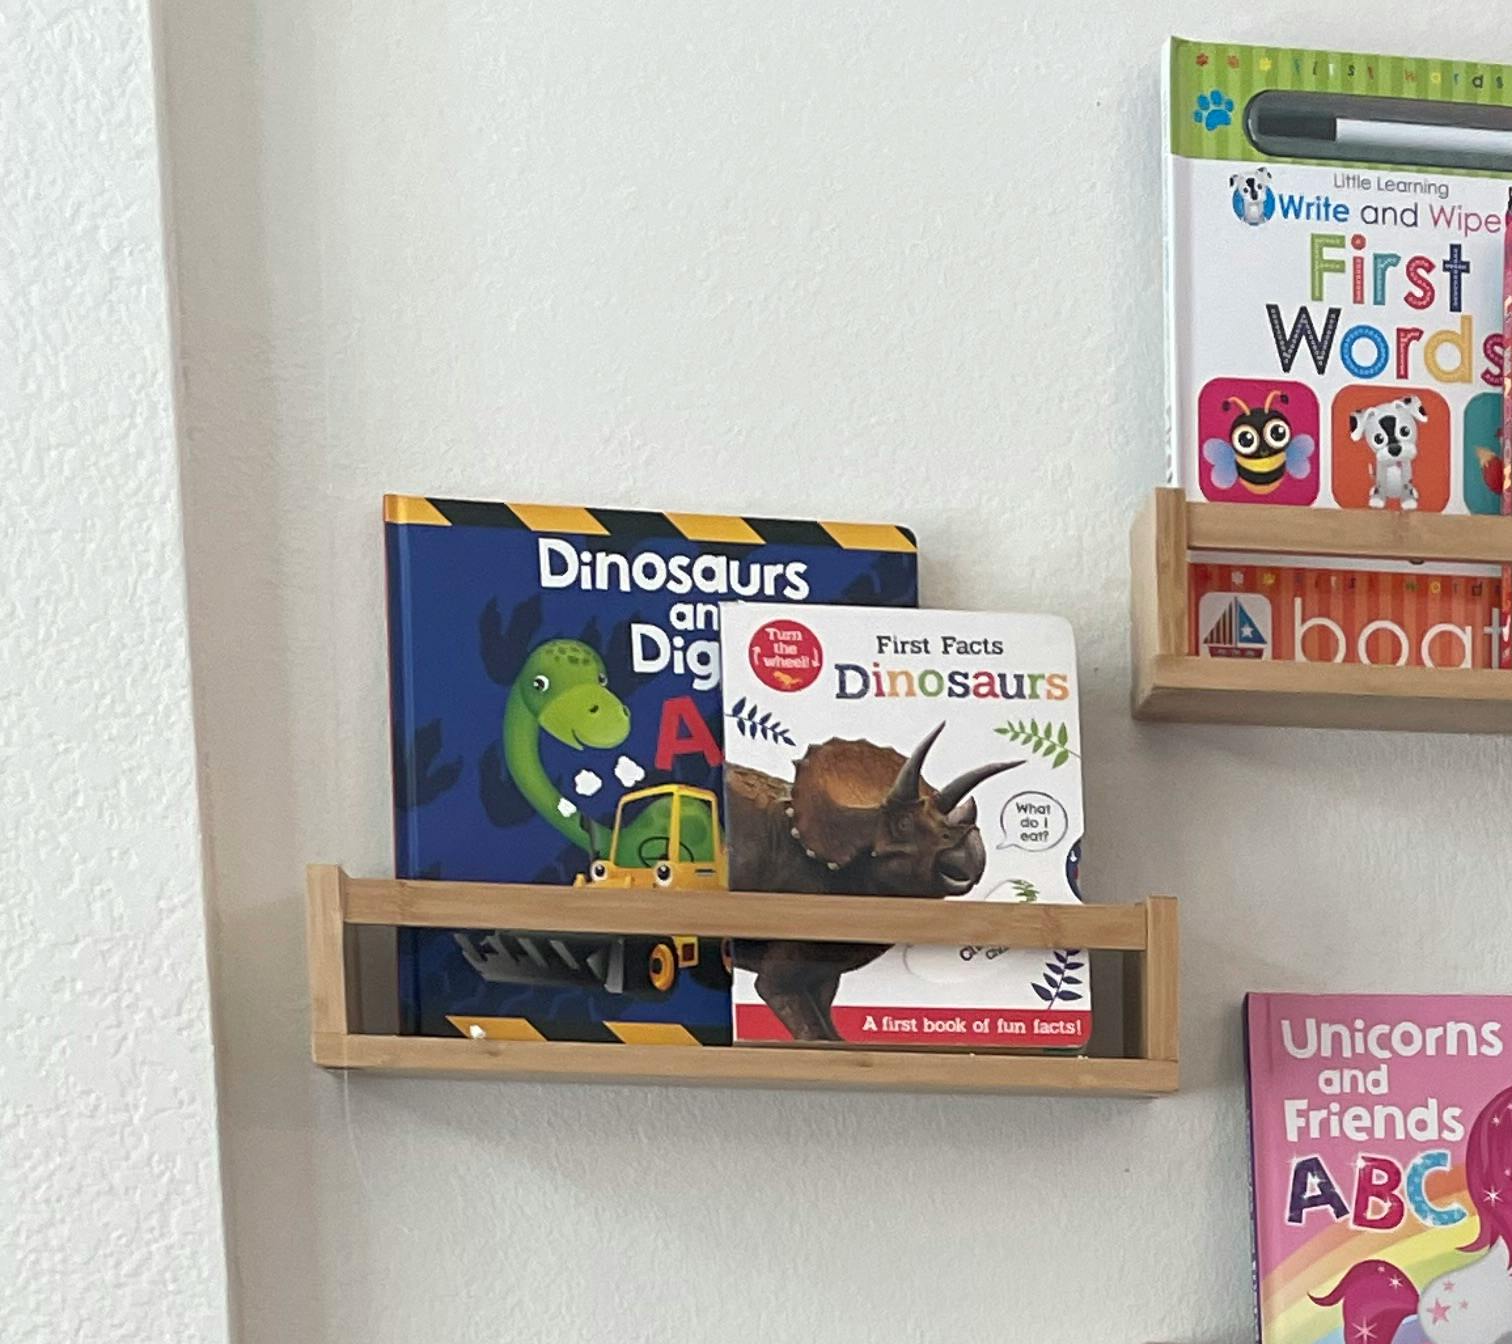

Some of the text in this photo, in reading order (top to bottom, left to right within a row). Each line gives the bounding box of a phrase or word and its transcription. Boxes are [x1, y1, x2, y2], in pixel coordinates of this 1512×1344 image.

[1333, 172, 1449, 199] Little Learning
[1279, 193, 1501, 236] Write and Wipe
[1310, 233, 1471, 312] First
[1265, 303, 1505, 386] Words
[538, 537, 811, 601] Dinosaurs
[669, 602, 720, 631] an
[1294, 596, 1509, 669] boat
[630, 623, 721, 691] Dig
[773, 642, 798, 655] the
[876, 635, 1004, 656] First Facts
[834, 662, 1071, 701] Dinosaurs
[1015, 801, 1051, 815] What
[1020, 816, 1039, 829] do
[1020, 830, 1049, 842] eat?
[862, 1016, 1083, 1036] A first book of fun facts!
[1281, 1018, 1503, 1059] Unicorns
[1318, 1064, 1389, 1095] and
[1283, 1098, 1465, 1142] Friends
[1286, 1150, 1467, 1231] ABC
